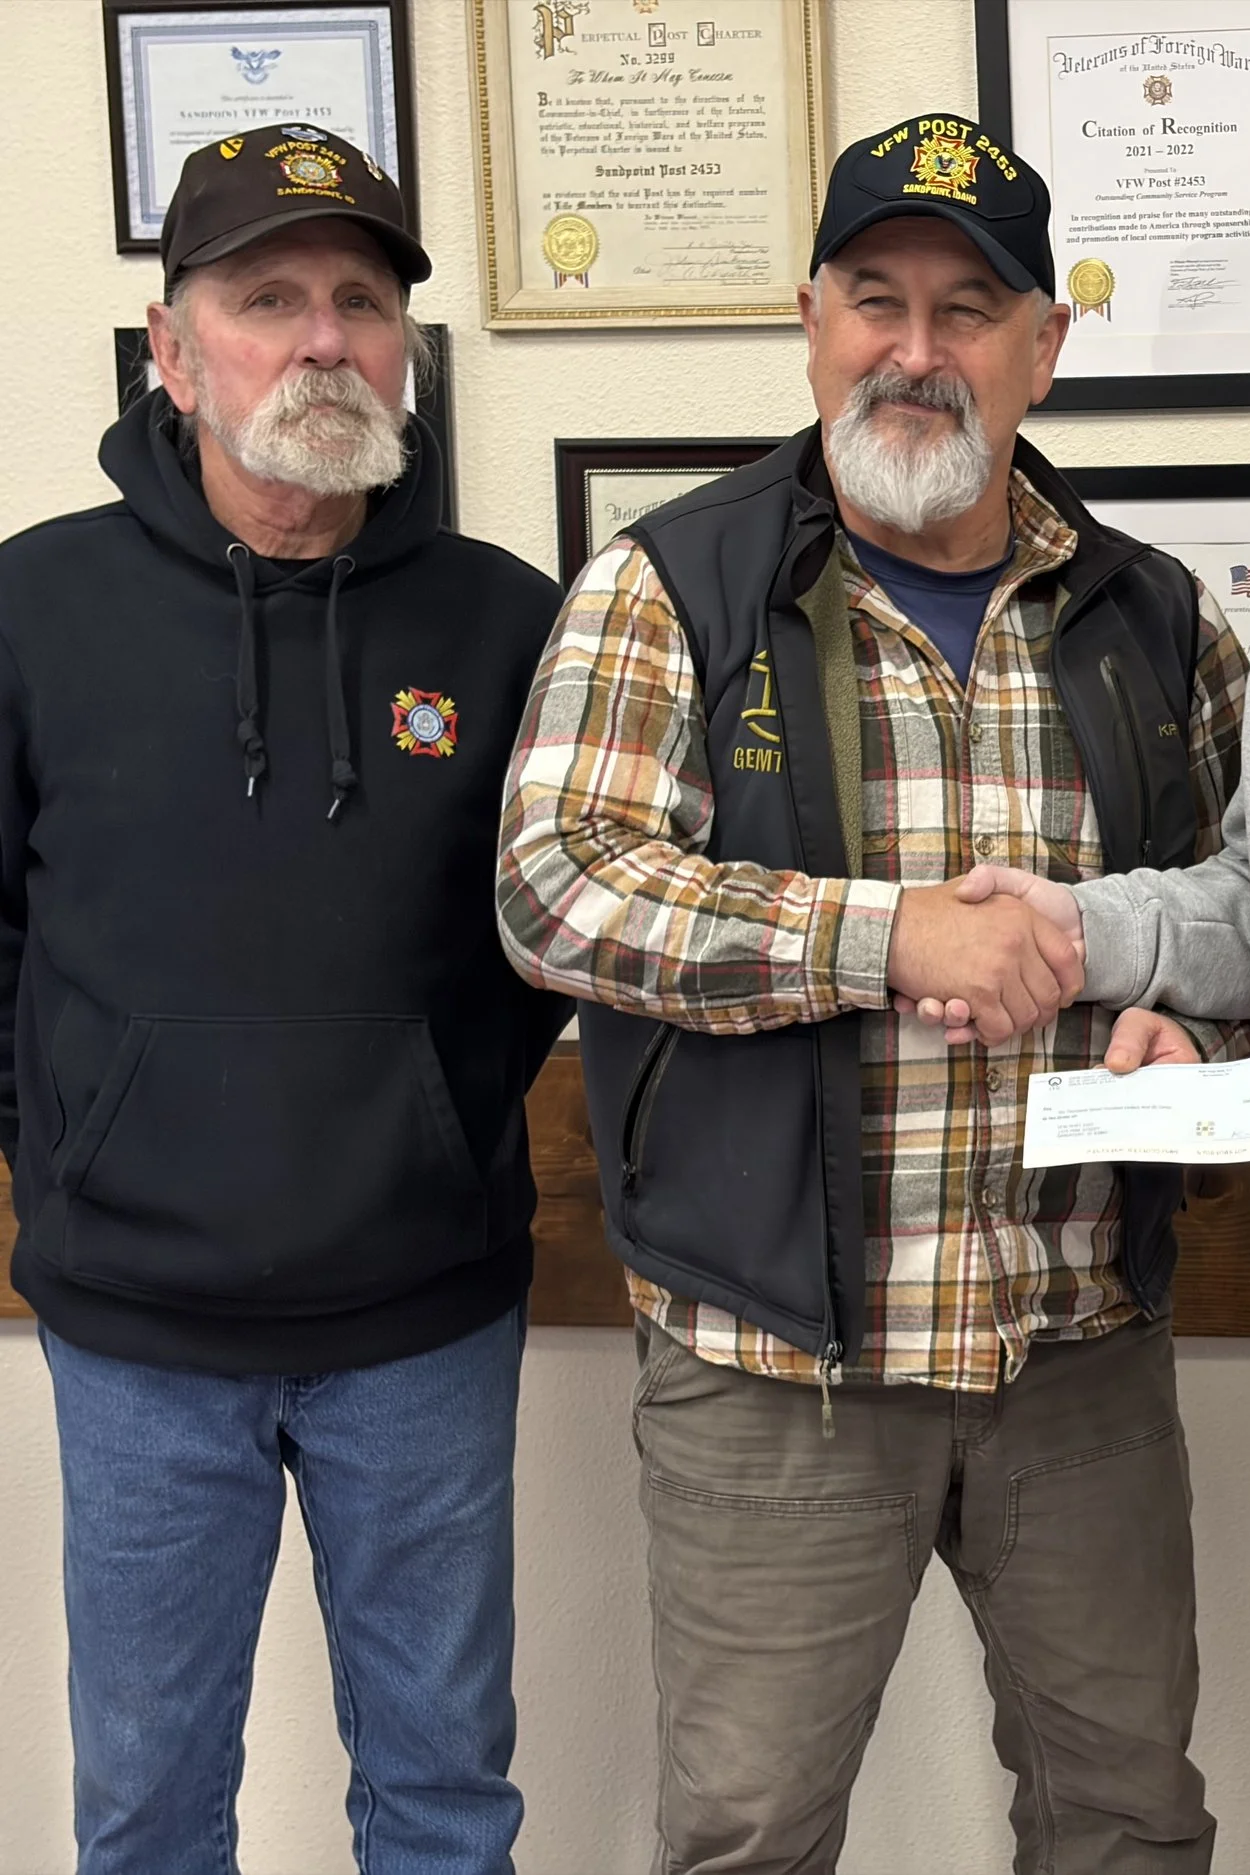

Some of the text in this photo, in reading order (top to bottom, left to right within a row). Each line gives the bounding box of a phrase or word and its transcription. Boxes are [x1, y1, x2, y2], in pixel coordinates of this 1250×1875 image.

[1052, 45, 1128, 80] Veterans
[1131, 36, 1150, 57] of
[1149, 35, 1216, 65] Foreign
[1081, 116, 1237, 138] Citation of Recognition
[287, 141, 318, 152] POST
[870, 127, 909, 158] VFW
[918, 119, 973, 140] POST
[975, 134, 1018, 182] 2453
[1125, 145, 1152, 158] 2021
[1166, 143, 1195, 156] 2022
[595, 163, 721, 180] Sandpoint Post 2453
[1116, 176, 1206, 189] VFW Post #2453
[952, 190, 977, 206] IDAHO
[1081, 213, 1121, 222] recognition
[1123, 212, 1137, 220] and
[1138, 212, 1161, 221] praise
[1188, 211, 1208, 219] many
[1069, 224, 1117, 233] contributions
[1118, 223, 1138, 231] made
[1149, 222, 1180, 230] America
[1181, 221, 1210, 229] through
[1081, 235, 1119, 244] promotion
[1130, 233, 1147, 241] local
[1148, 232, 1189, 242] community
[1191, 232, 1223, 241] program
[604, 499, 666, 523] Veteran
